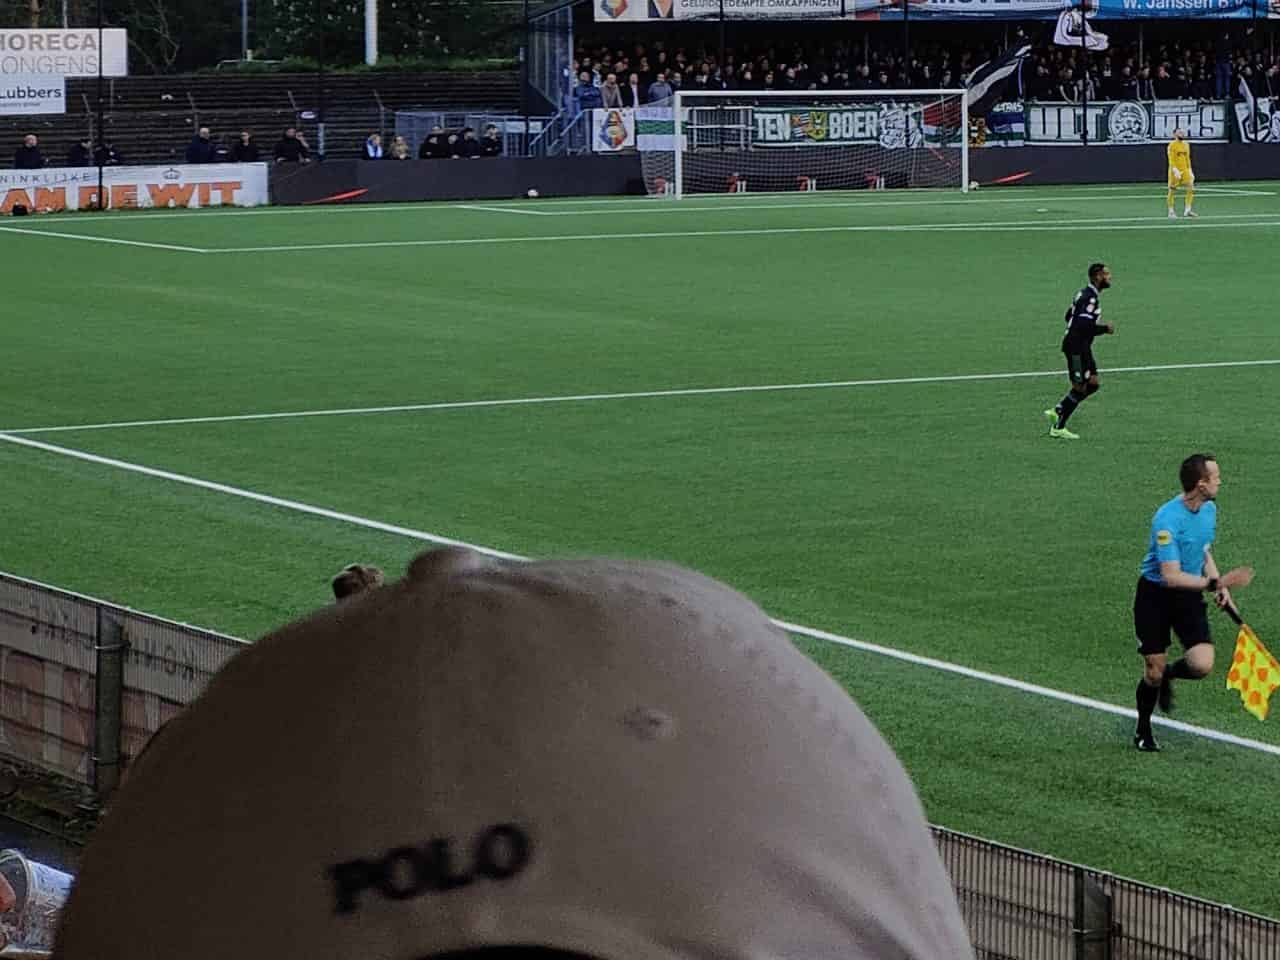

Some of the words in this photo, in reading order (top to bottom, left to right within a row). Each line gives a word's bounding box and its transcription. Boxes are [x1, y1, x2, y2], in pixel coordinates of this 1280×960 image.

[767, 0, 840, 8] OMKAPPINGEN
[753, 113, 791, 141] TEN
[829, 111, 878, 139] BOER
[78, 184, 138, 211] DE
[146, 181, 243, 209] WIT
[329, 823, 532, 917] POLO
